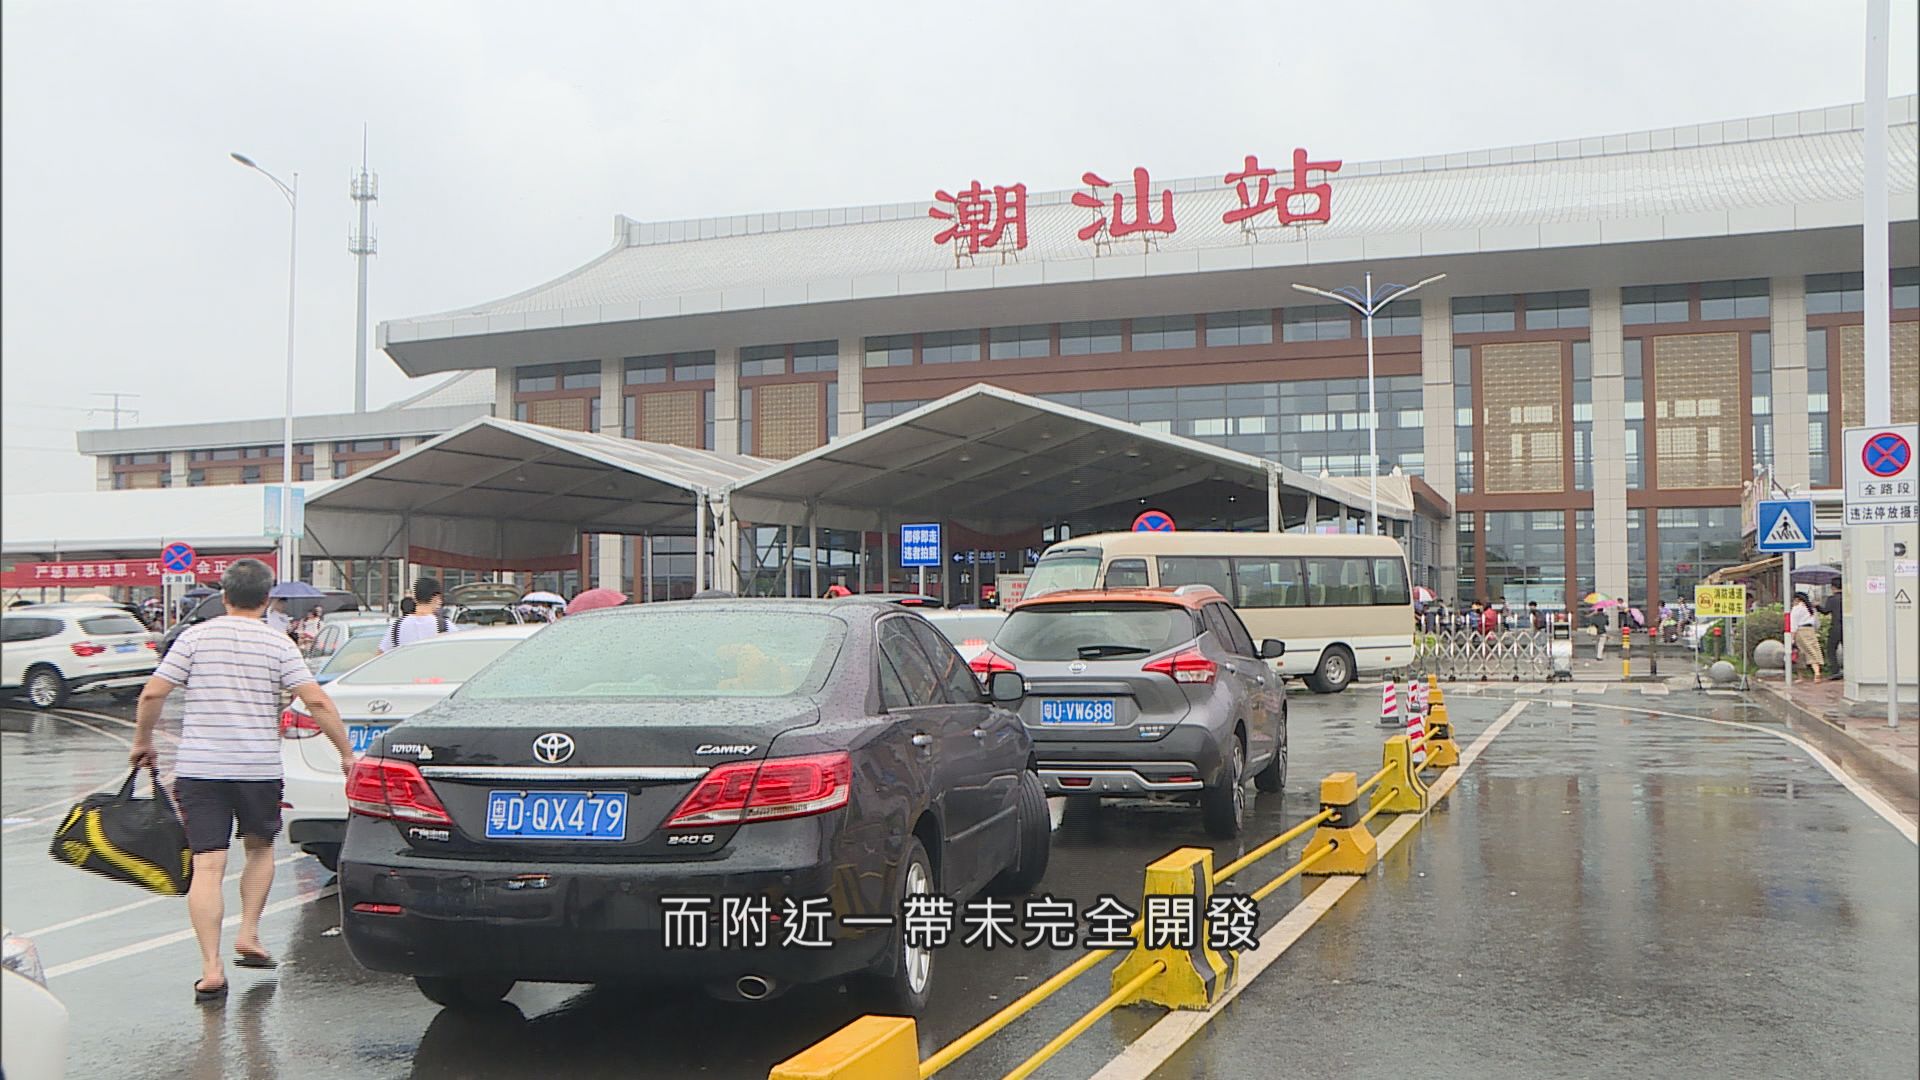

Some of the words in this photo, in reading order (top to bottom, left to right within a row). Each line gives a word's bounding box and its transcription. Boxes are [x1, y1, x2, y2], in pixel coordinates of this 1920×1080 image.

[928, 147, 1343, 255] 潮汕站
[1863, 482, 1911, 496] 全路段
[1713, 588, 1743, 600] 消防通道
[1714, 602, 1743, 614] 禁止停车
[391, 744, 421, 754] TOYOTA
[667, 835, 700, 845] 240
